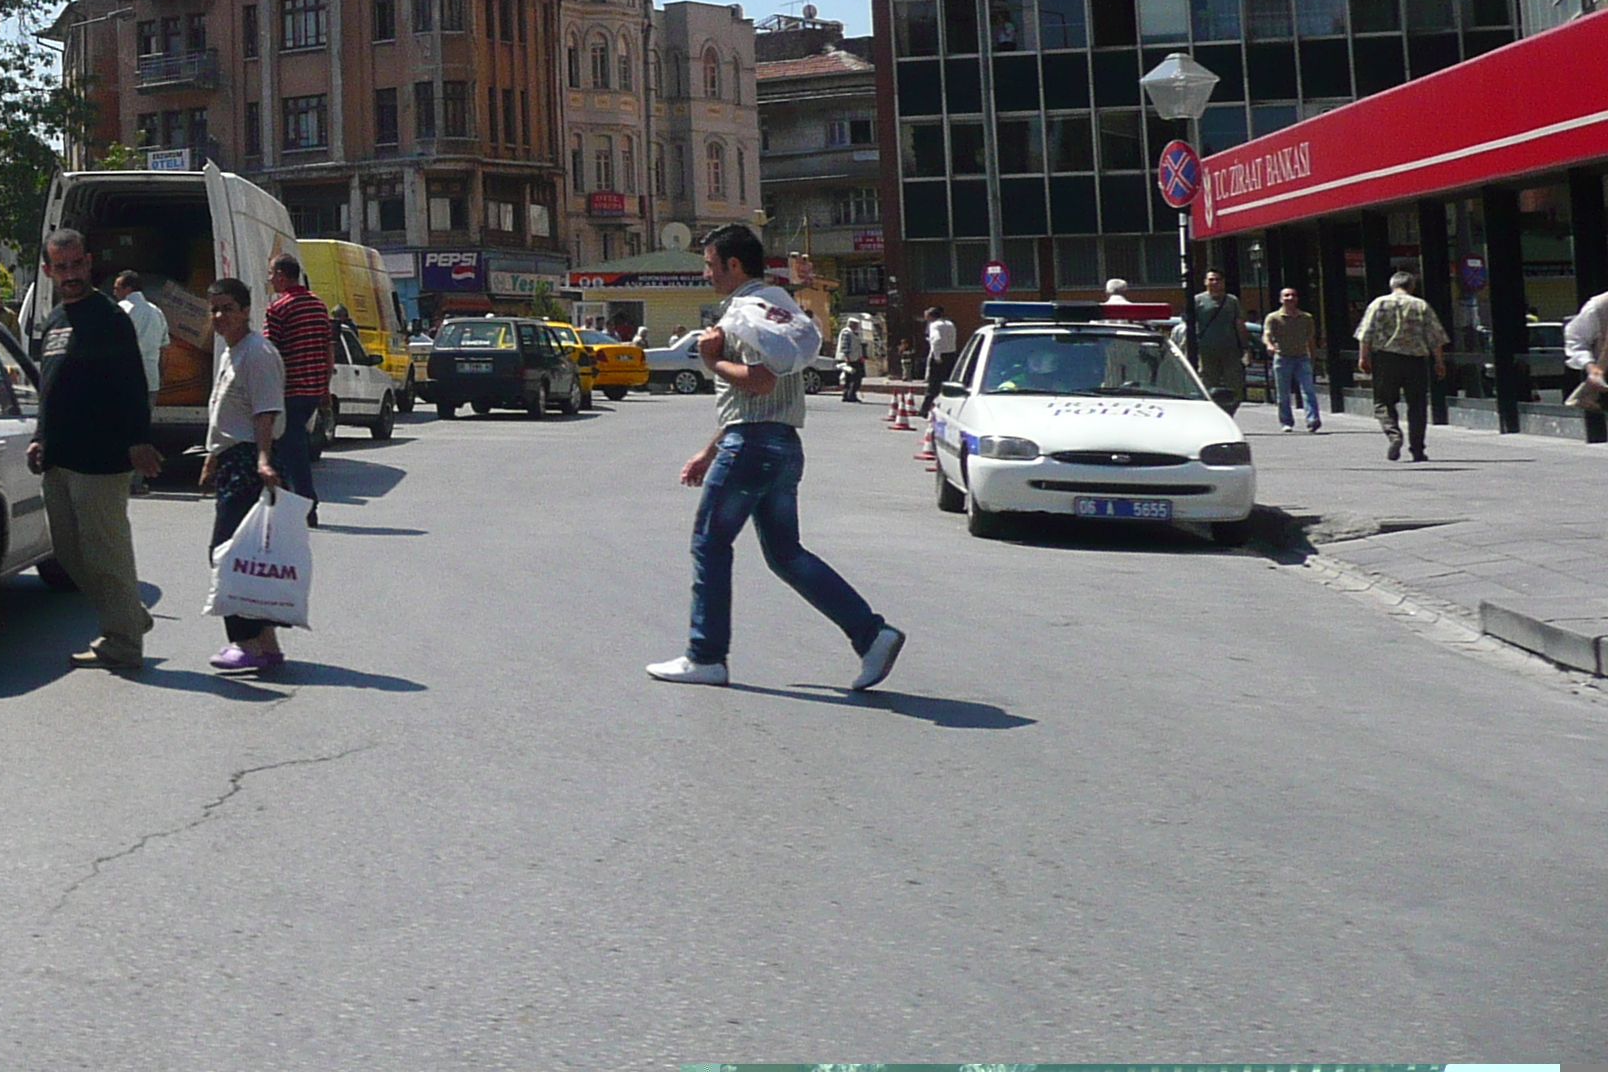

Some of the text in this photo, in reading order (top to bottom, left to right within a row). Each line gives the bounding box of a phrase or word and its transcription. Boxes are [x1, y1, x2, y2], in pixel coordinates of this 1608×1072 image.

[1229, 158, 1262, 197] ZİRAAT
[1265, 141, 1311, 186] BANKASI
[425, 252, 478, 267] PEPSI
[1106, 501, 1115, 515] A
[233, 556, 297, 581] NİZAM
